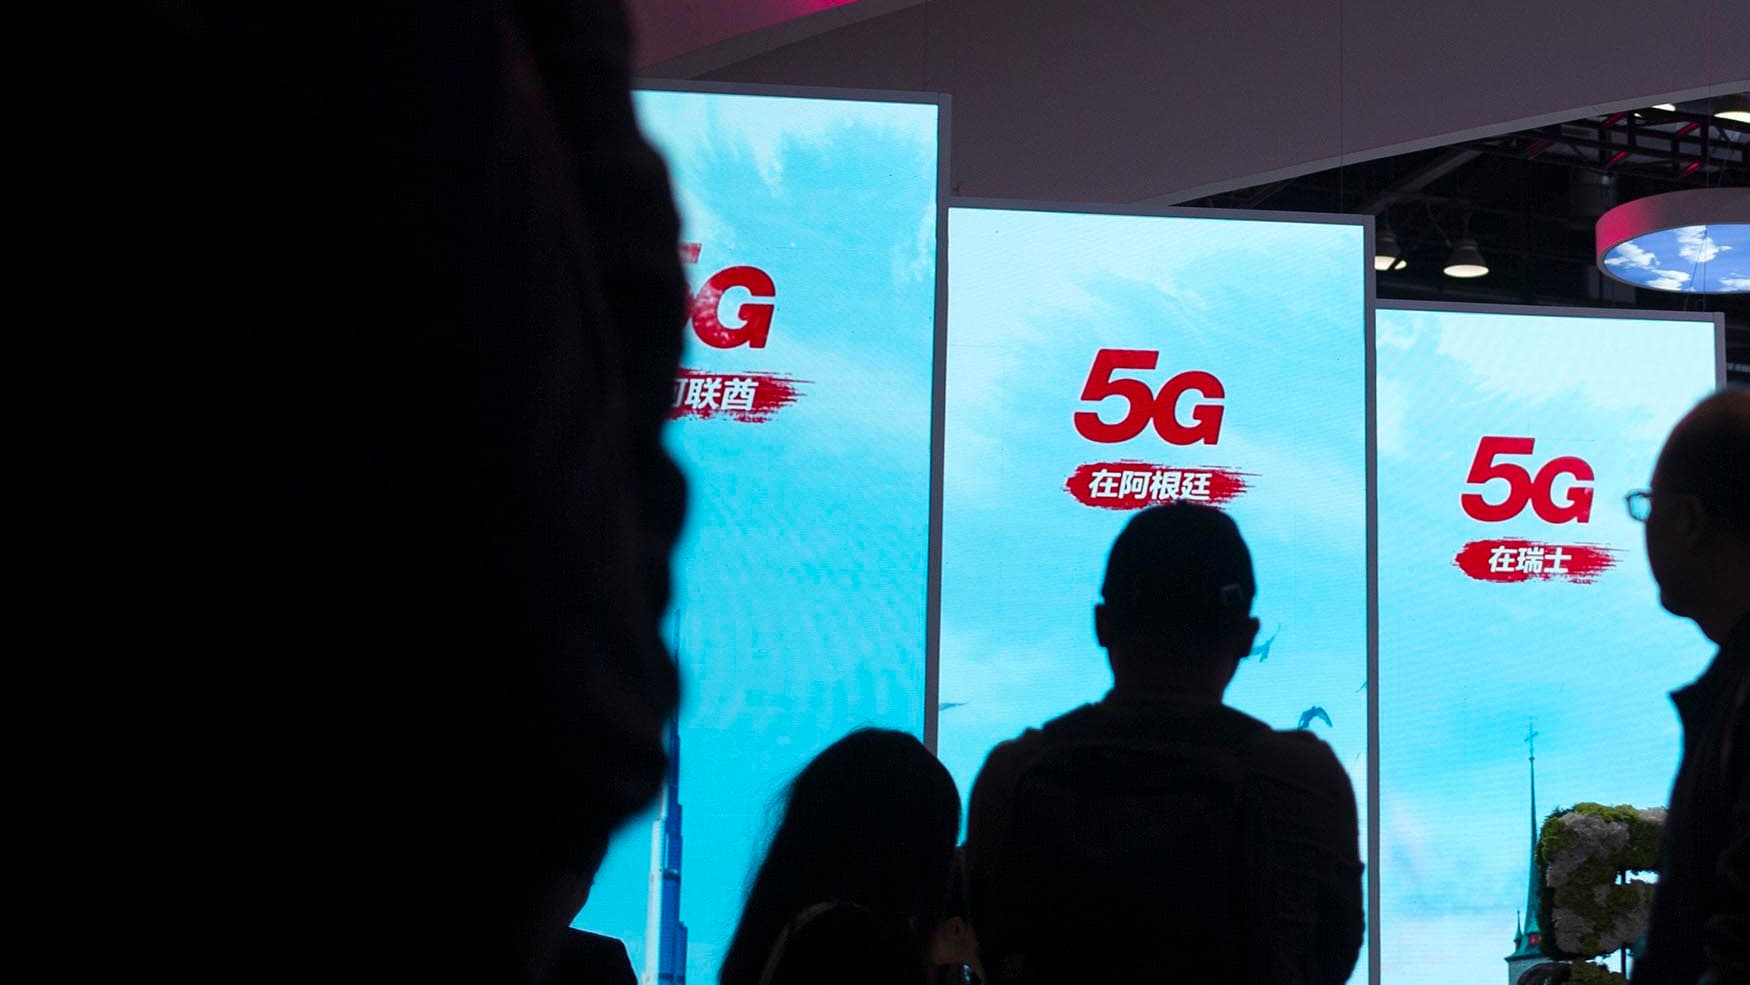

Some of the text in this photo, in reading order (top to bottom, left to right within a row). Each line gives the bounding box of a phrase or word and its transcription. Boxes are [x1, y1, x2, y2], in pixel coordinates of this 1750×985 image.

[672, 376, 759, 411] 联酋
[1073, 348, 1225, 446] 5G
[1088, 469, 1212, 501] 在阿根廷
[1461, 436, 1595, 524] 5G
[1488, 545, 1572, 574] 在瑞士
